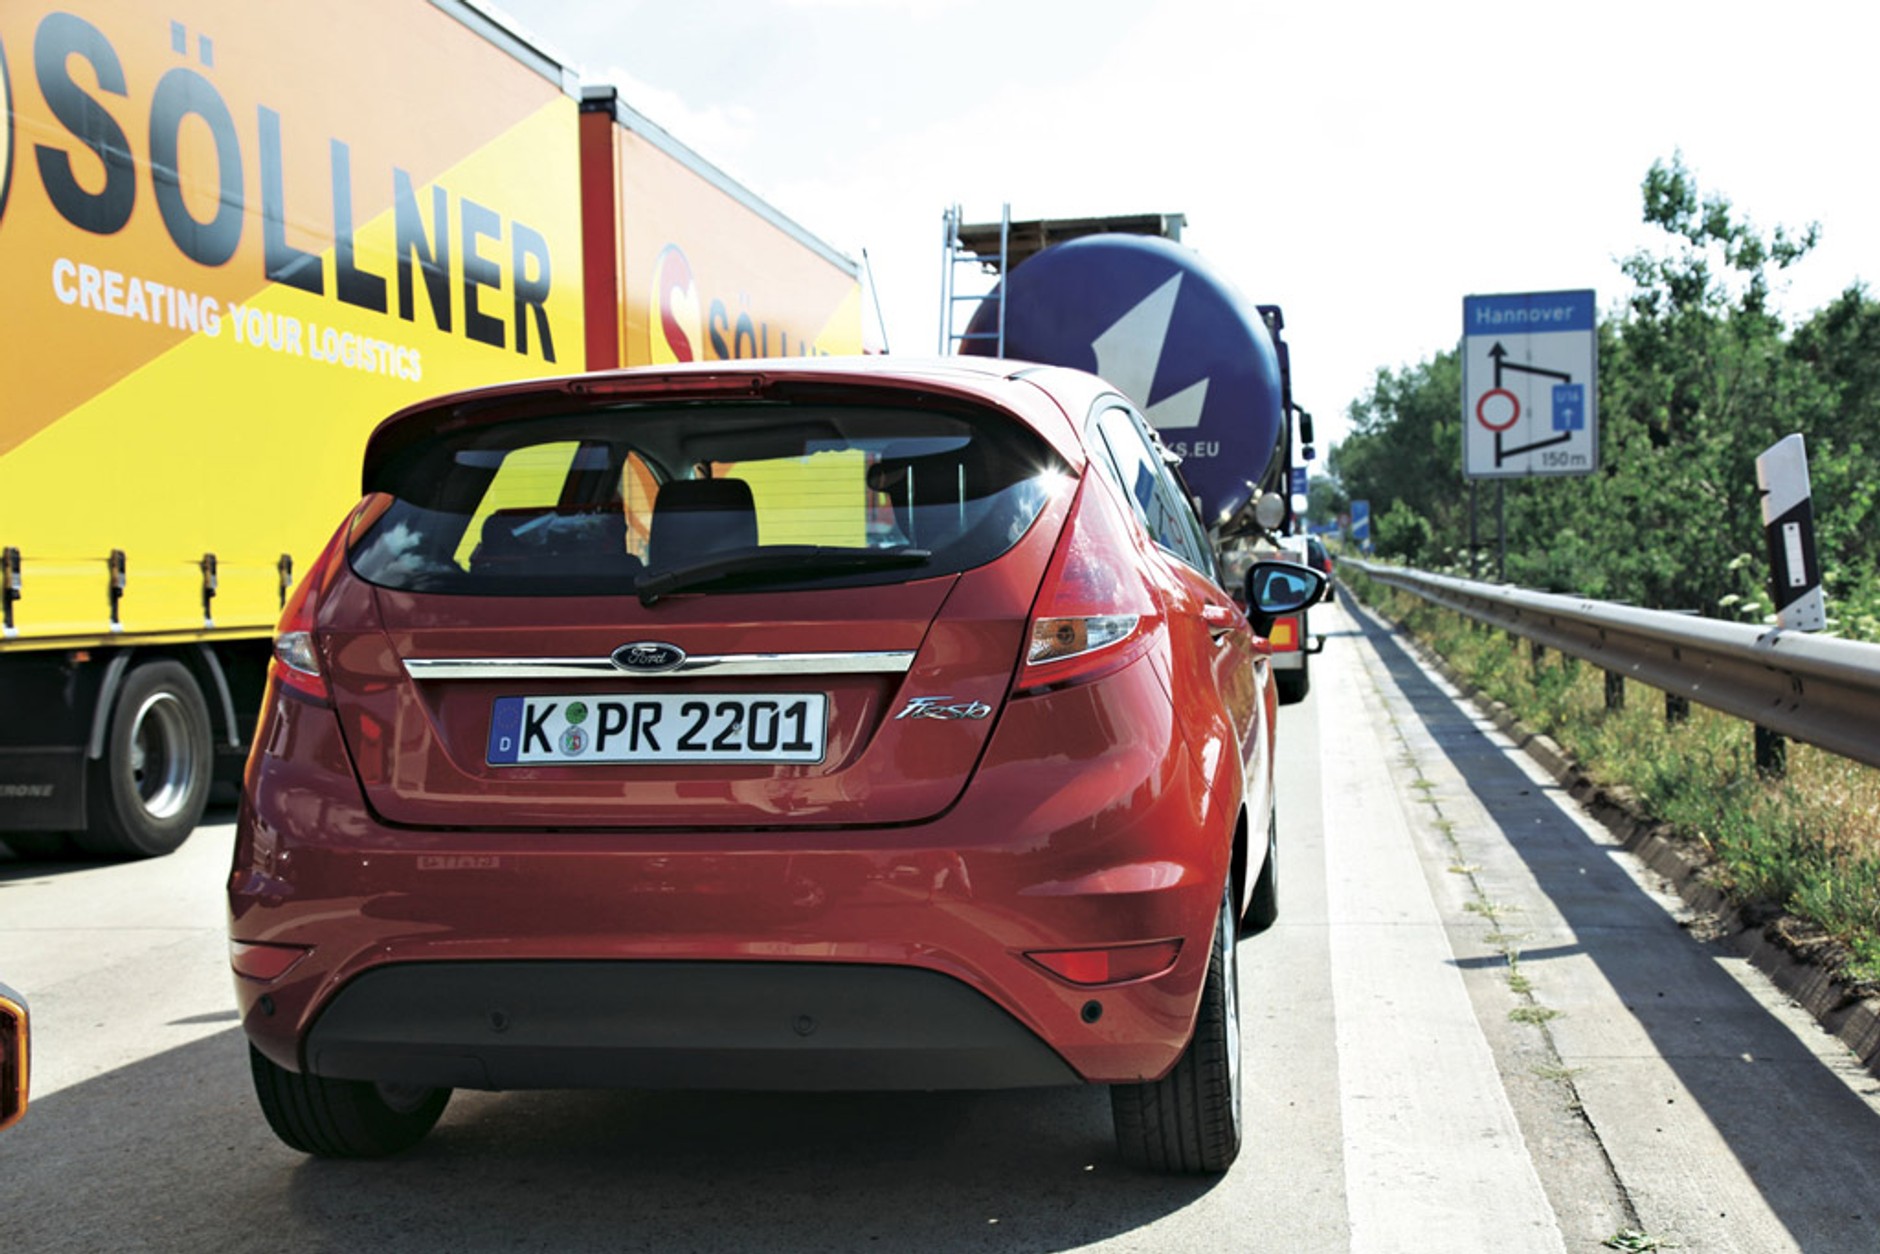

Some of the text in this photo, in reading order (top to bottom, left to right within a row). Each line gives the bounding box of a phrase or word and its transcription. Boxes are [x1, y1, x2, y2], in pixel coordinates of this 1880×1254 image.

[33, 11, 557, 364] SÖLLNER
[52, 257, 423, 383] CREATING YOUR LOGISTICS
[1475, 304, 1576, 325] Hannover
[627, 647, 668, 664] Ford
[894, 695, 991, 720] Fiesta
[522, 701, 813, 754] K PR 2201
[499, 736, 512, 753] D
